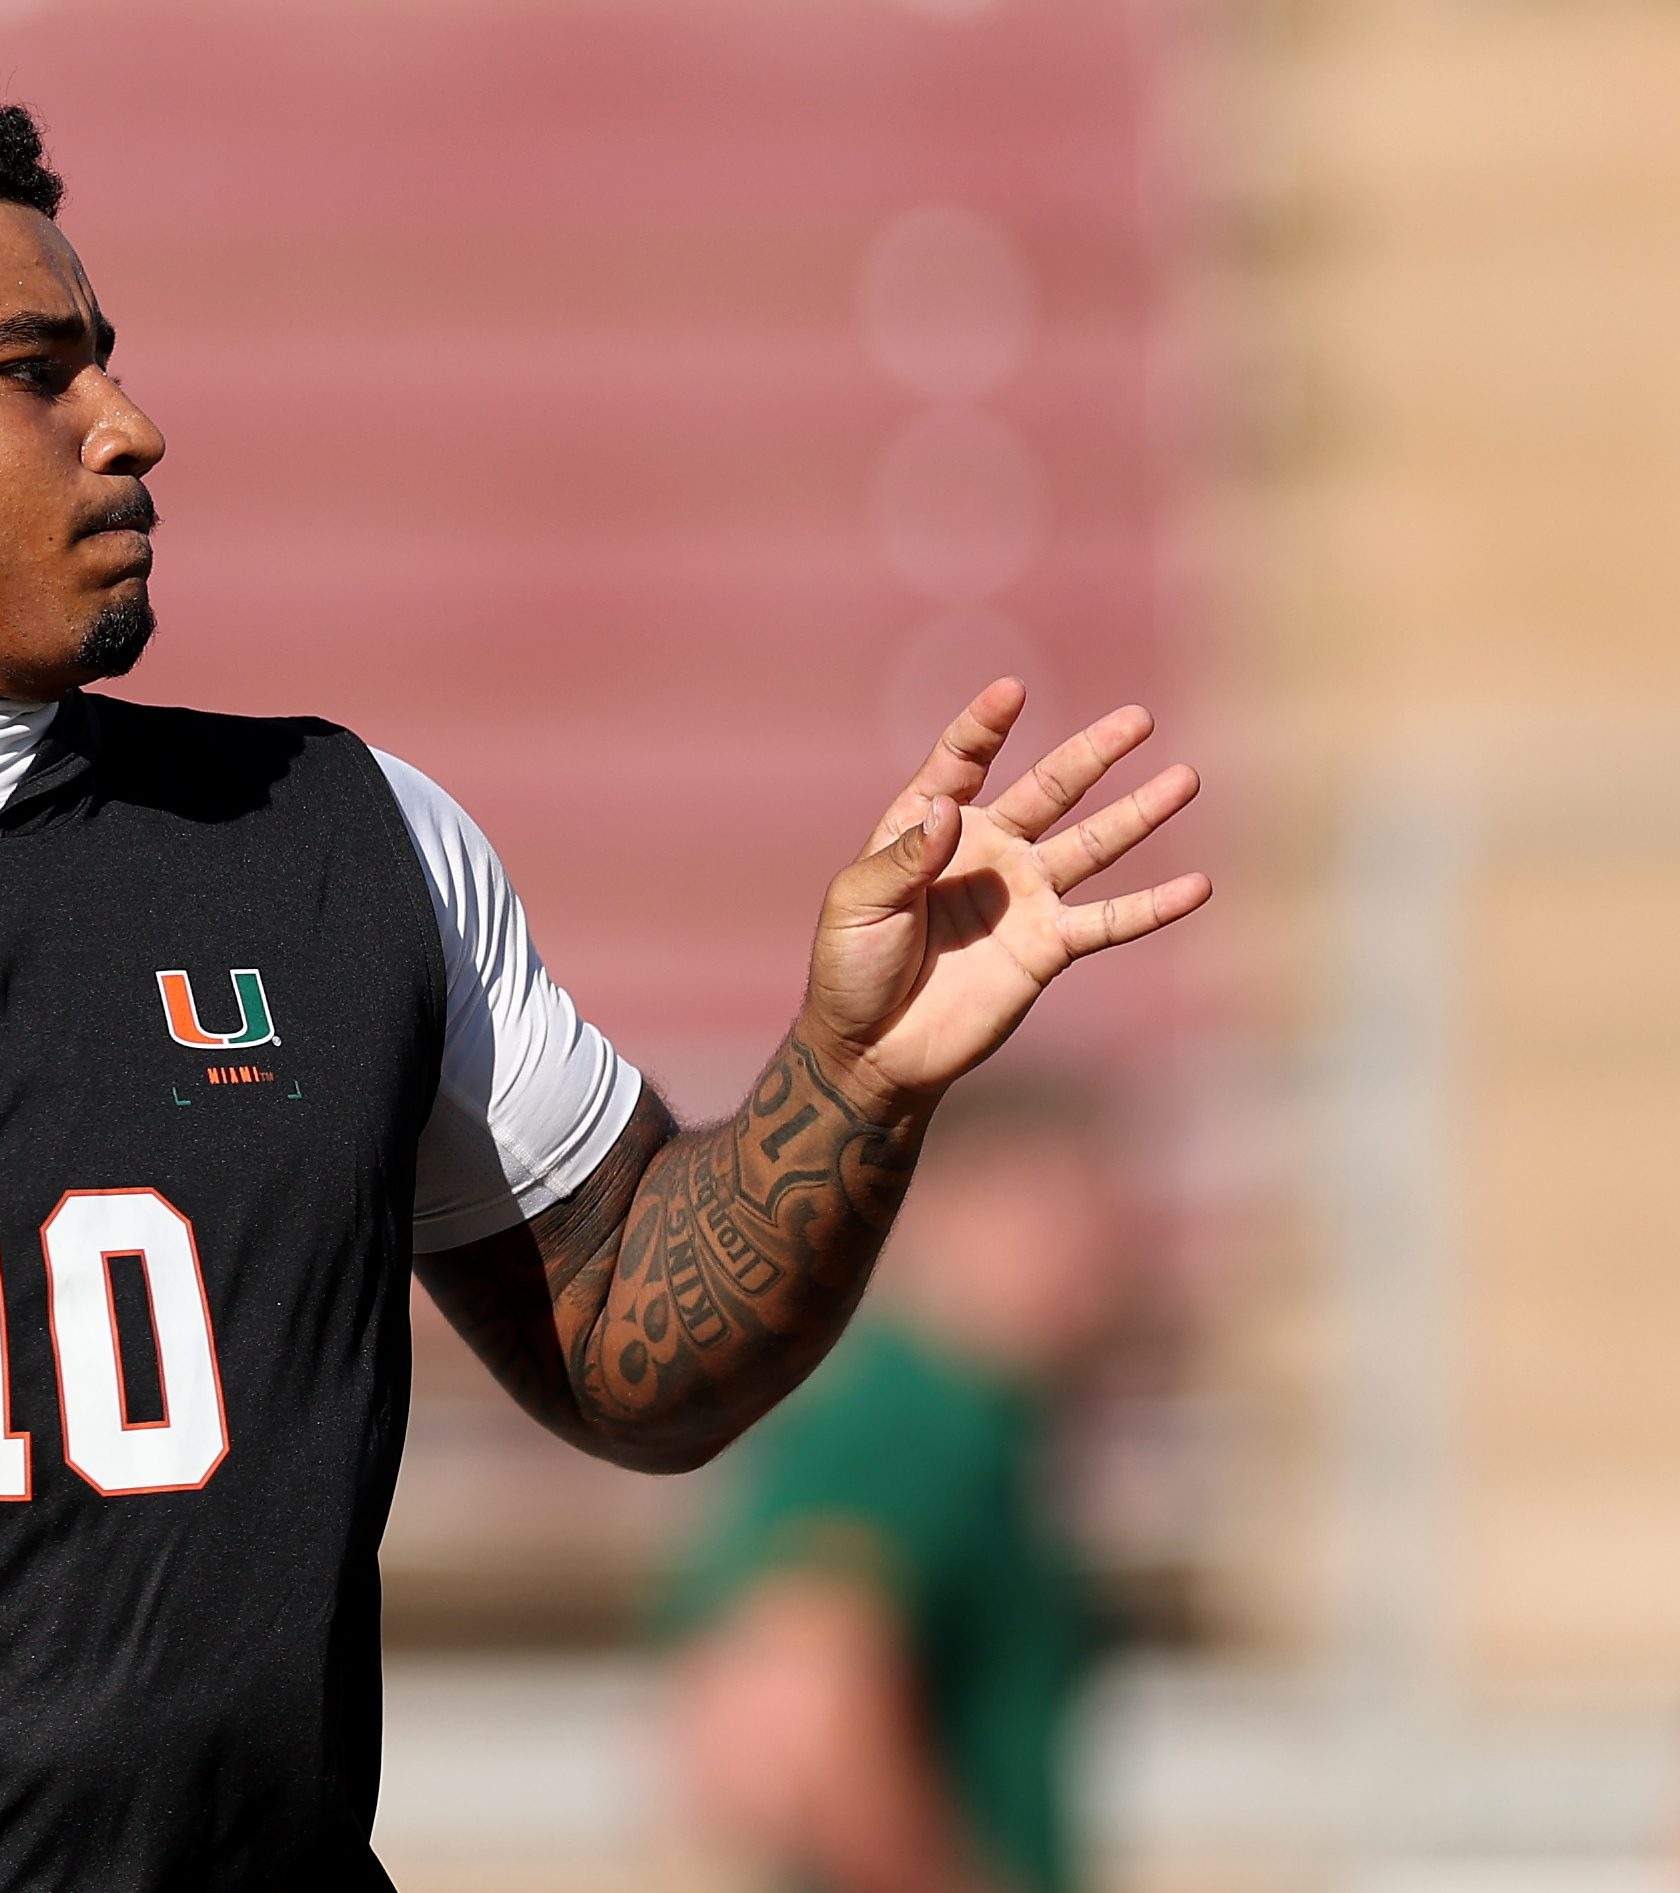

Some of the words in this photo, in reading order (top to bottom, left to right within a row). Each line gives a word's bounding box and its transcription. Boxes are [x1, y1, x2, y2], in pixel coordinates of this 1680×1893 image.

[155, 969, 275, 1049] U
[207, 1066, 260, 1084] MIAMI
[753, 1062, 820, 1162] 10
